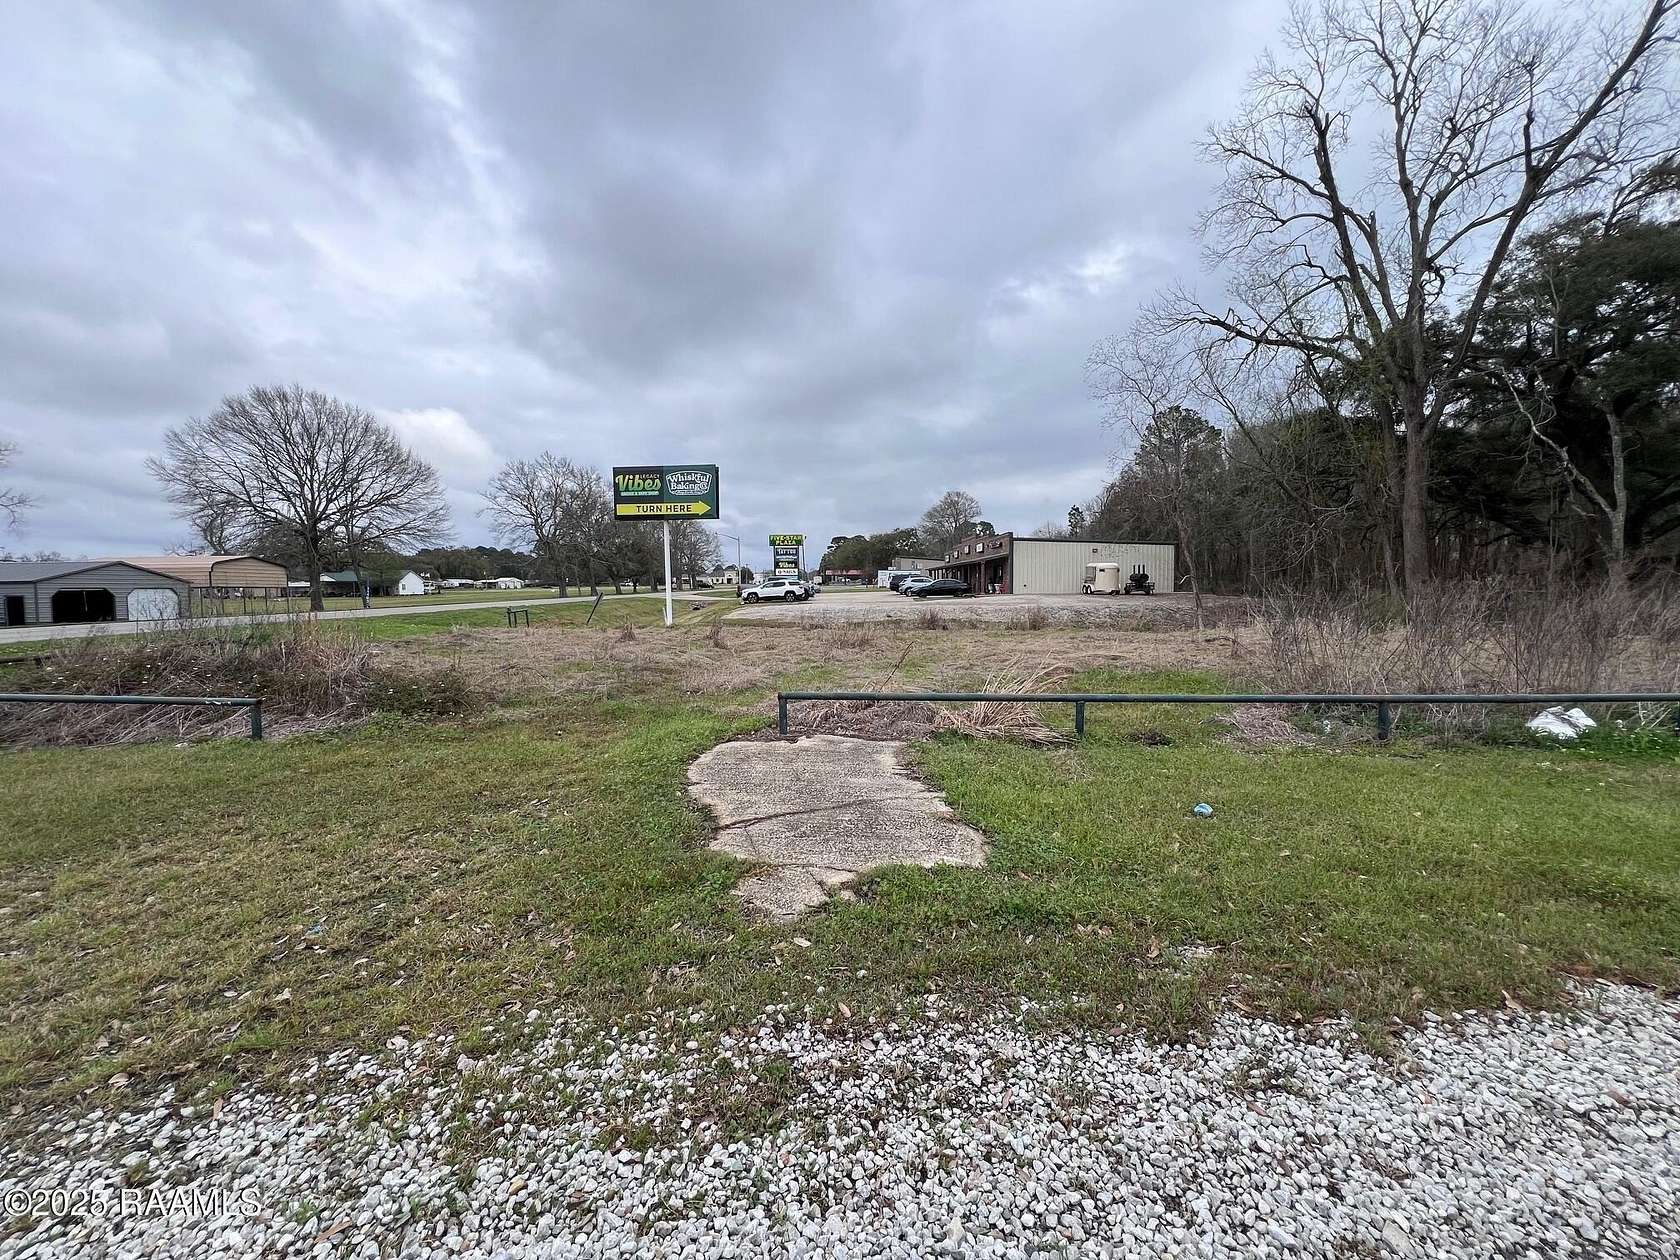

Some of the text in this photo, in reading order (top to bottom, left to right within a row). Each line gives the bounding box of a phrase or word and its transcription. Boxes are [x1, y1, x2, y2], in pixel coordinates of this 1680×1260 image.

[615, 474, 661, 491] Vibes
[669, 473, 710, 483] Whiskful
[670, 481, 699, 491] Baking
[636, 504, 692, 513] TURN HERE
